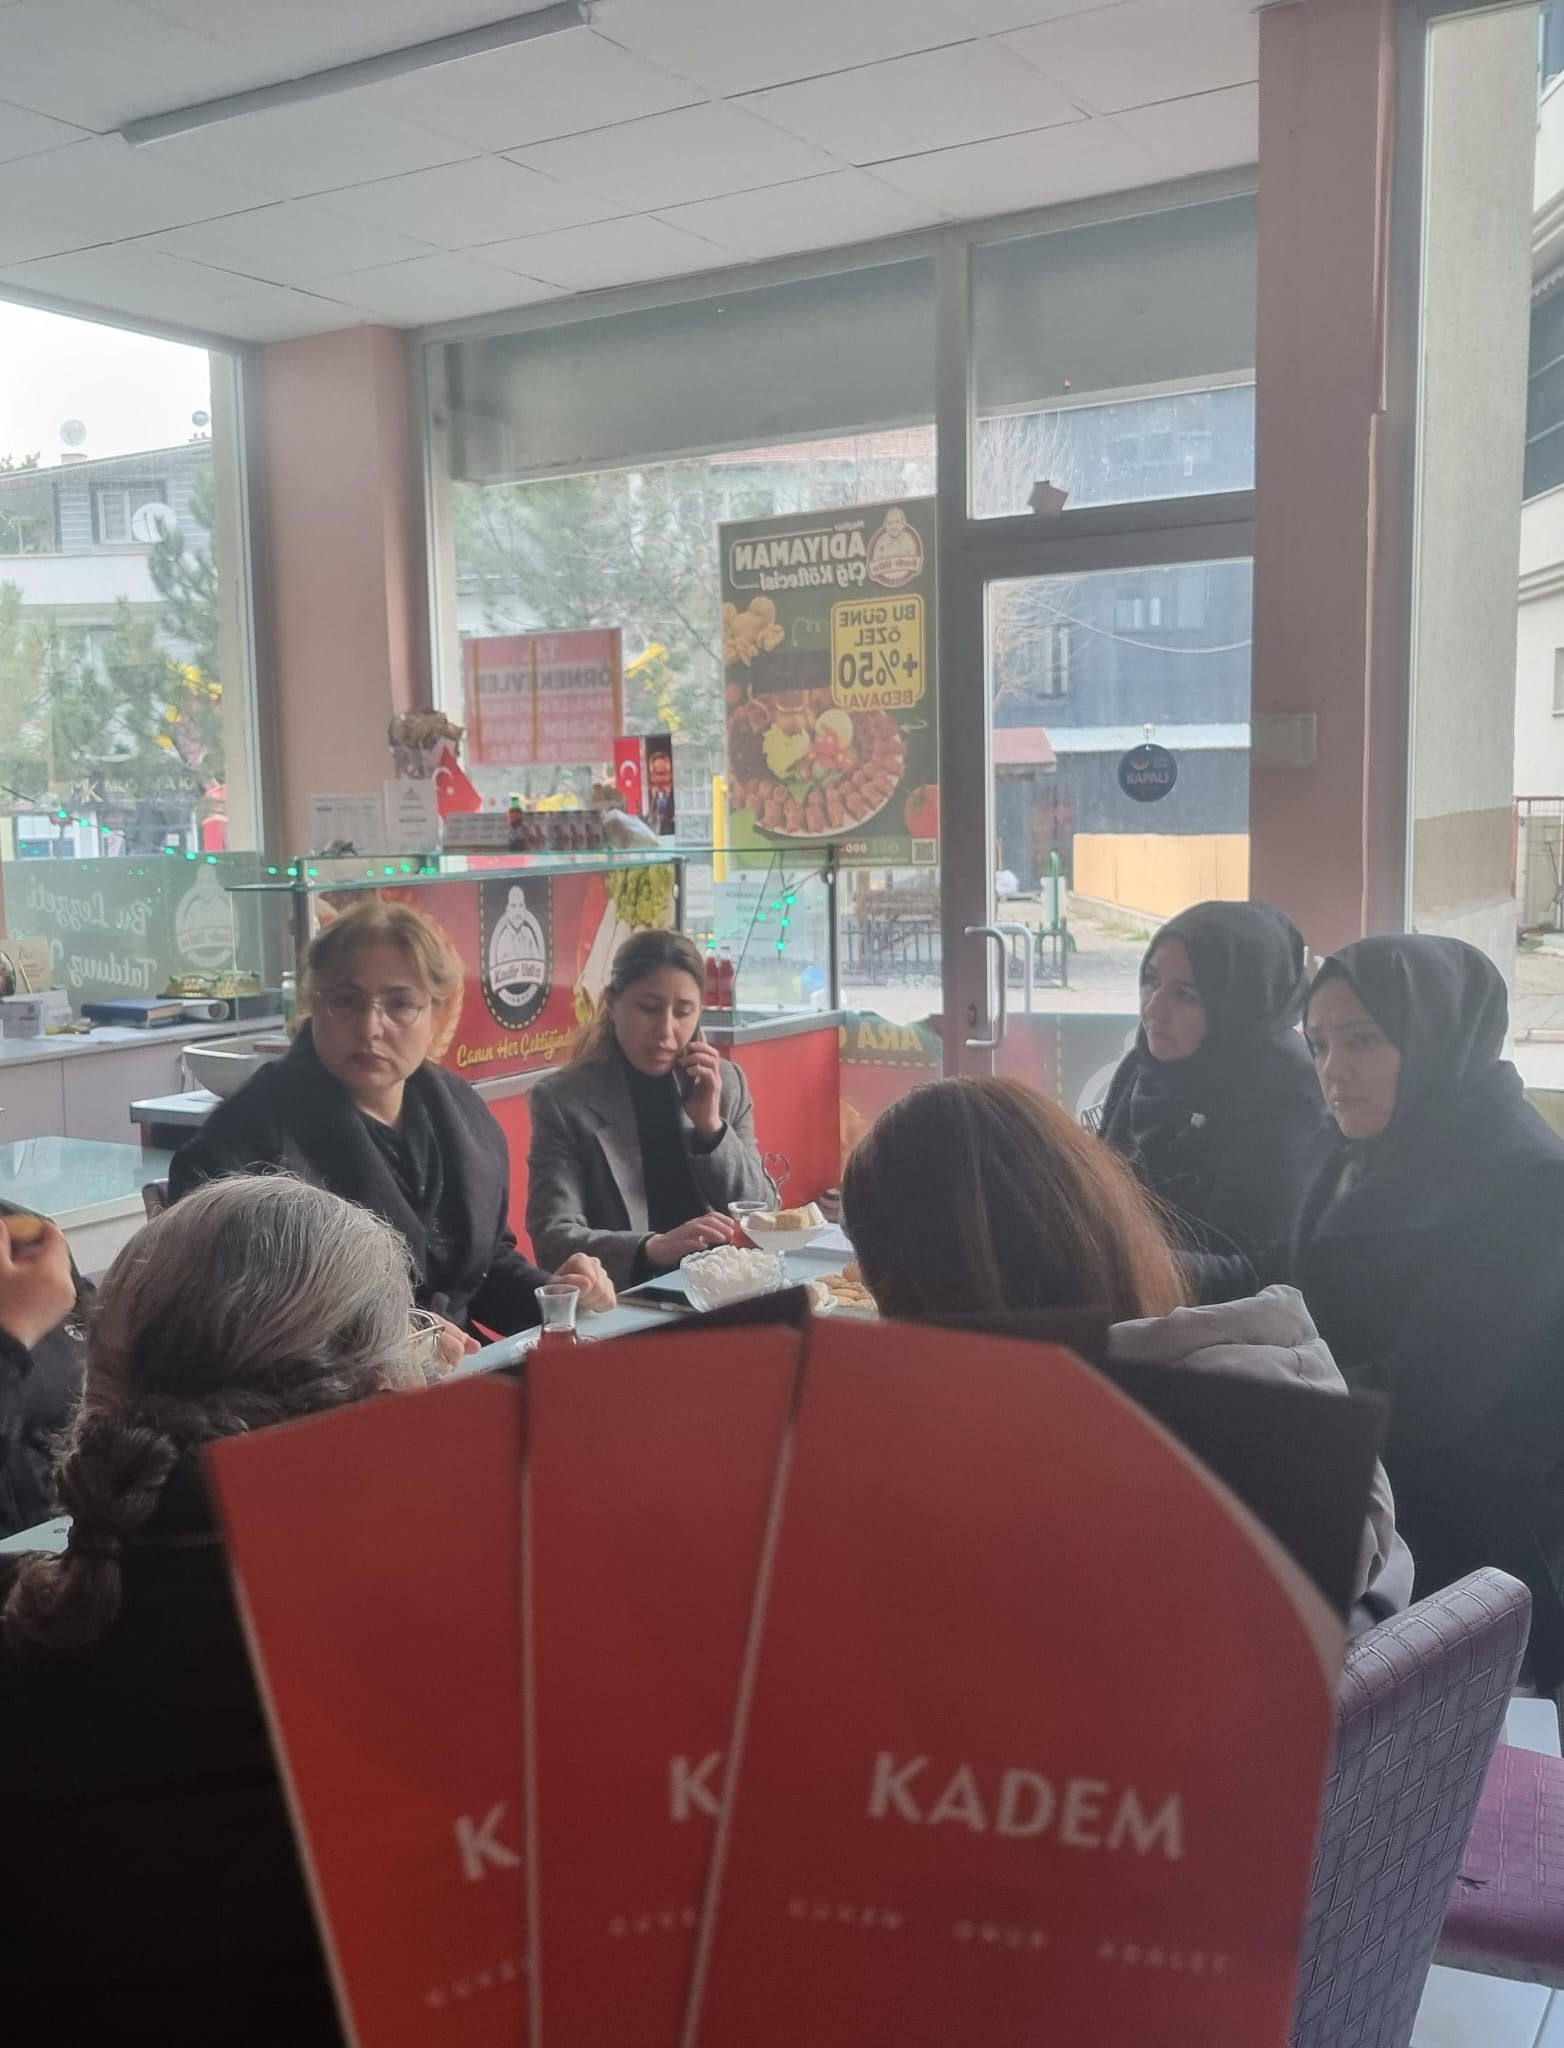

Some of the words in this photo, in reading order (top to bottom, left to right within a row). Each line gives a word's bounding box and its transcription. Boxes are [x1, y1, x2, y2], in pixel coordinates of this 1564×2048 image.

[457, 1044, 494, 1067] Canın
[497, 1037, 519, 1059] Her
[867, 1751, 1187, 1860] KADEM
